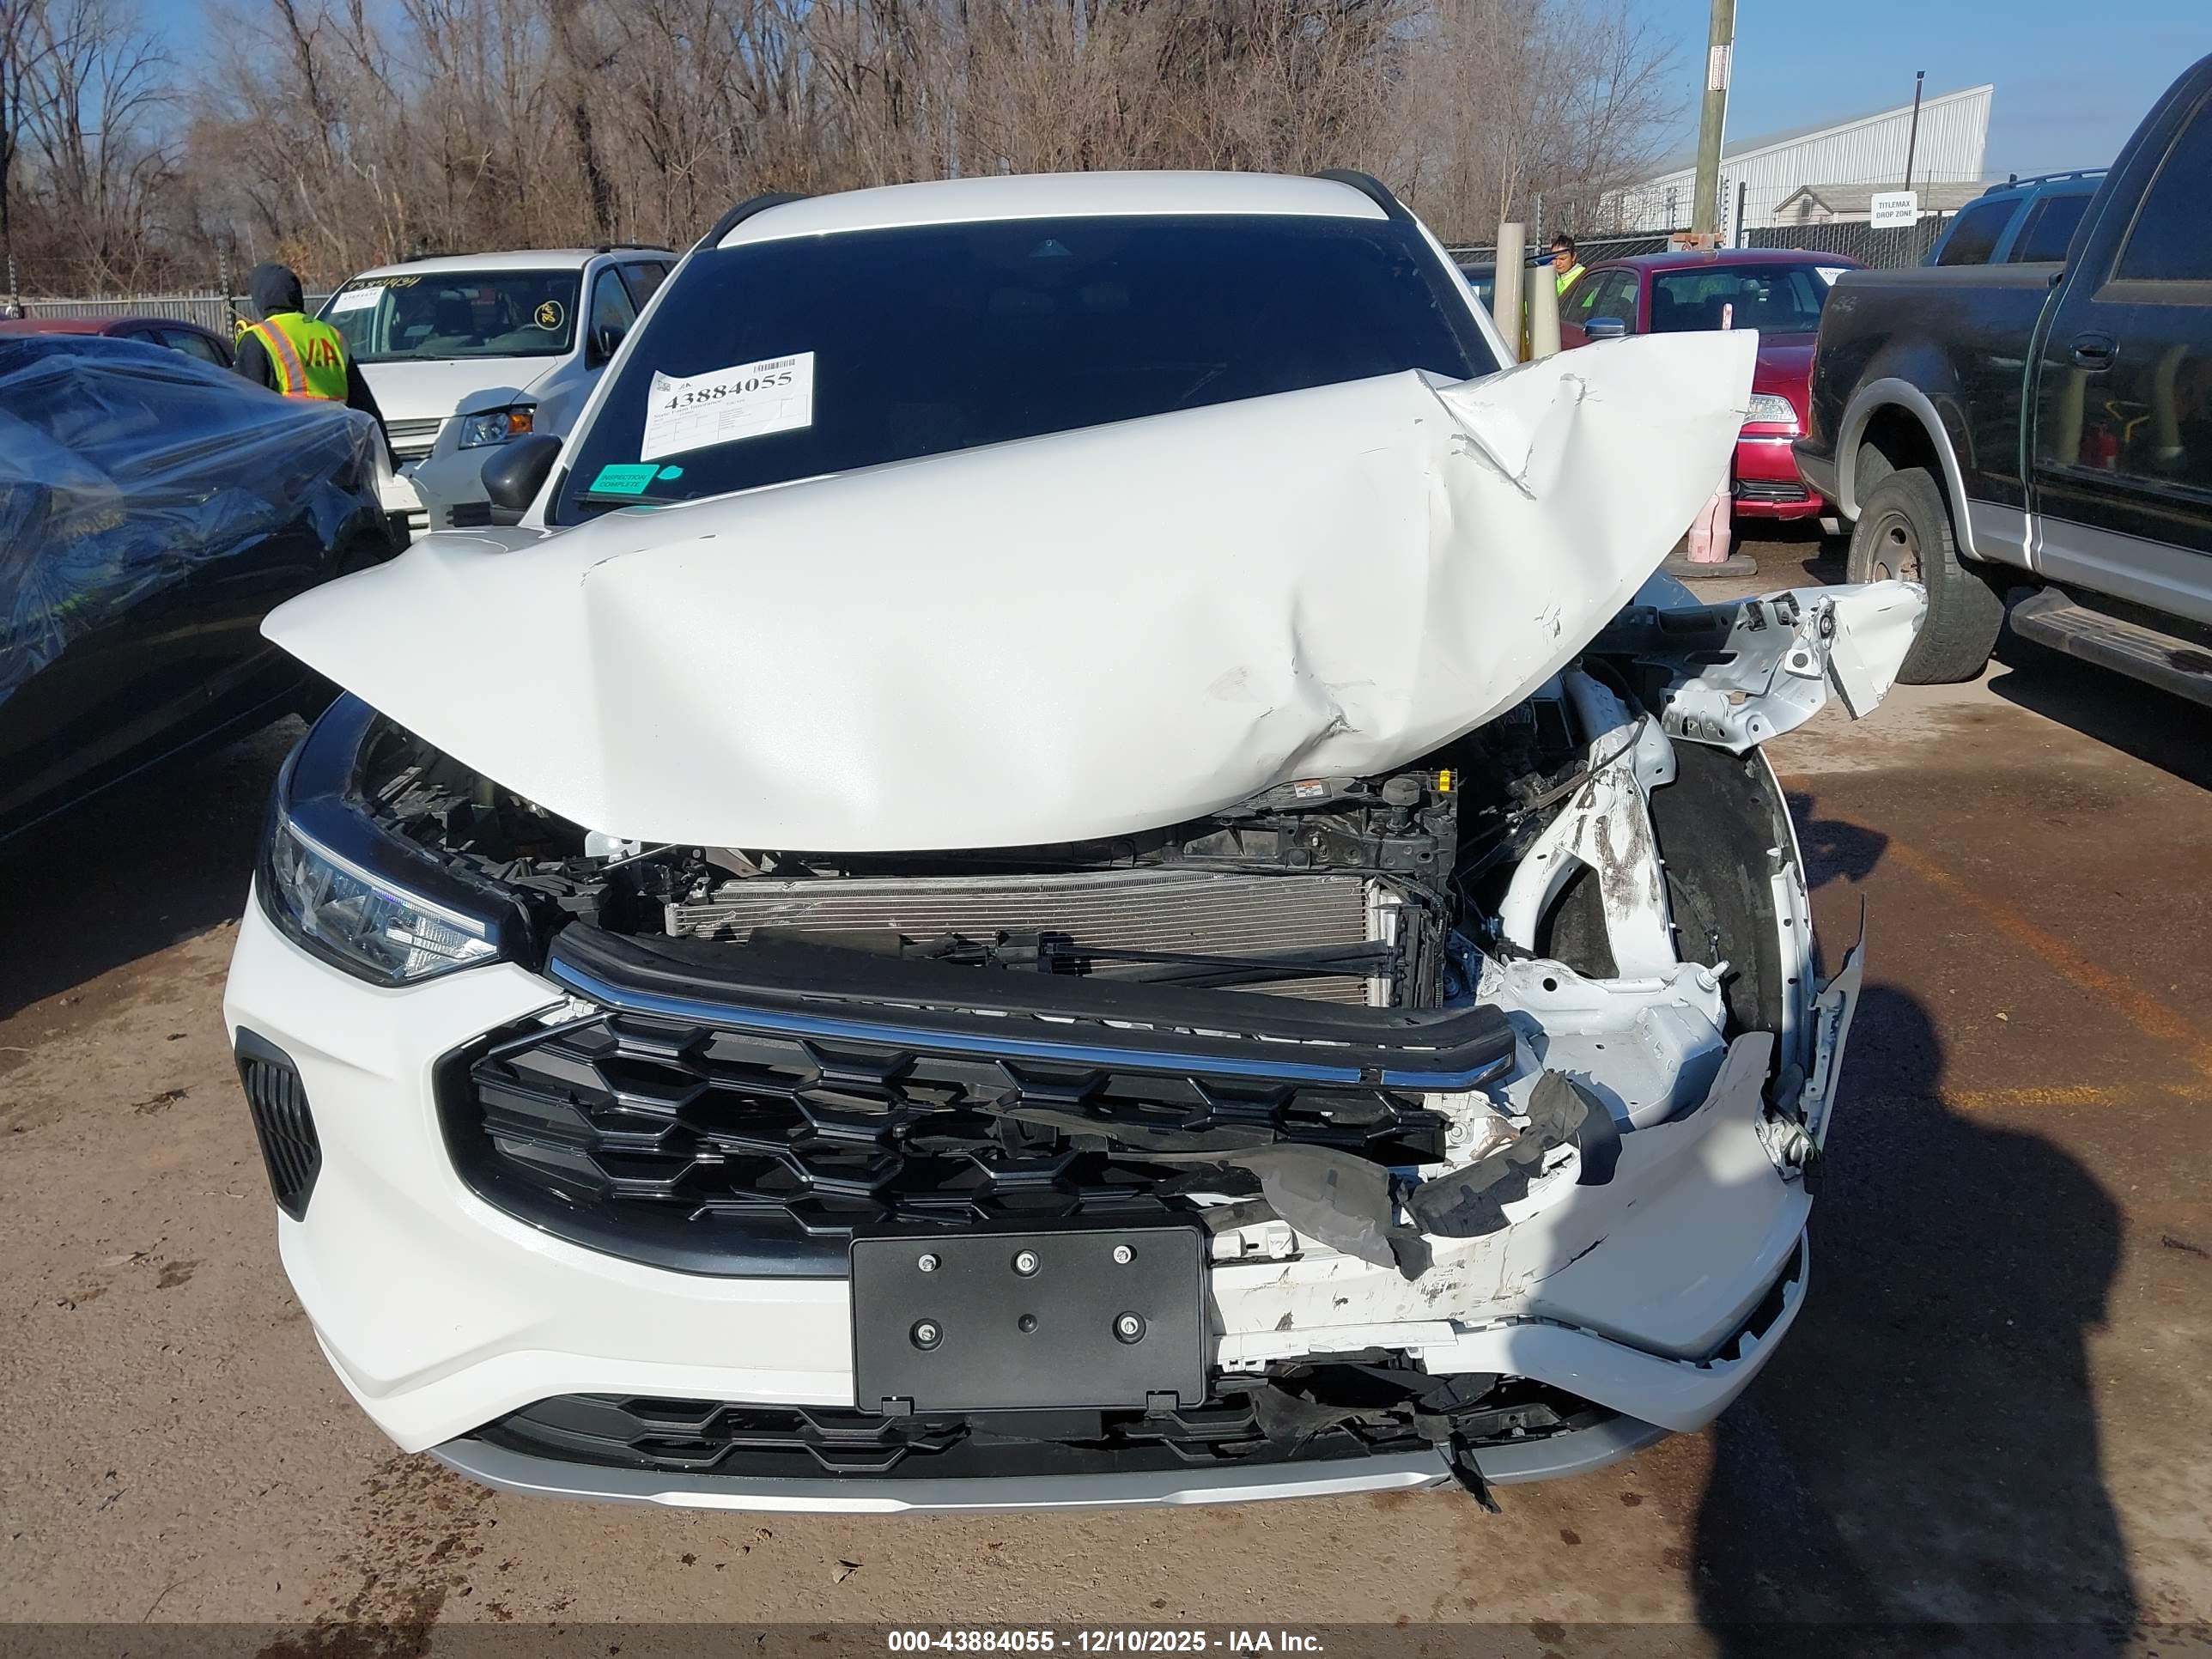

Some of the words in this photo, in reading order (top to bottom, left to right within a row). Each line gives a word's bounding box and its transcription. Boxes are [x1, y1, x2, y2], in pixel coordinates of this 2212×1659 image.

[1878, 200, 1911, 209] TITLEMAX
[1895, 210, 1912, 218] ZONE
[664, 371, 793, 410] 43884055
